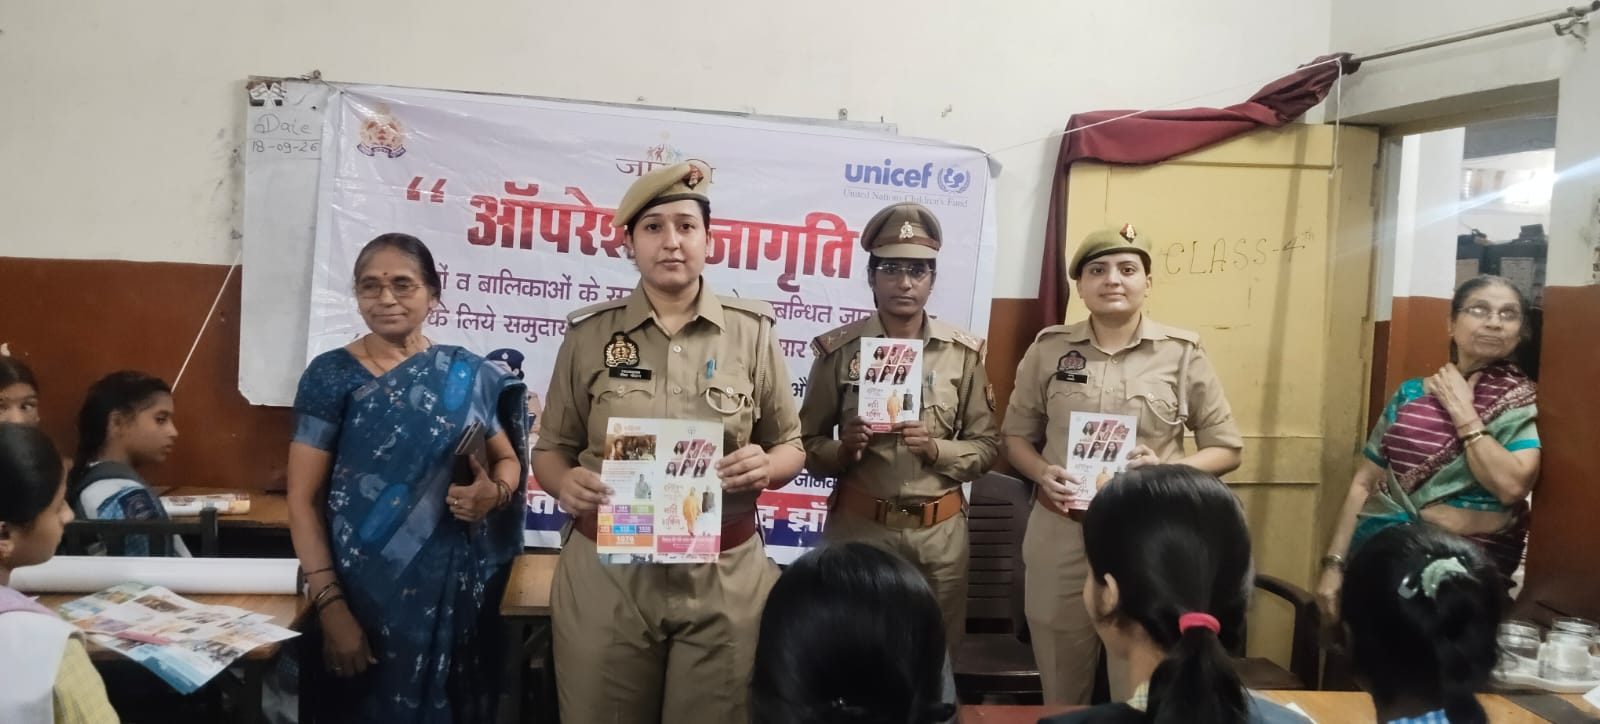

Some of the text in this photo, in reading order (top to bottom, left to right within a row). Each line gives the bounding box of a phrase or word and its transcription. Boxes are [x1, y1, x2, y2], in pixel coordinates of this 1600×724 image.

[844, 158, 933, 189] unicef
[843, 188, 870, 200] United
[871, 191, 902, 202] Nations
[947, 198, 968, 208] Fund
[456, 271, 472, 292] व
[478, 268, 573, 300] बालिकाओं
[578, 276, 600, 303] के
[456, 302, 497, 332] लिये
